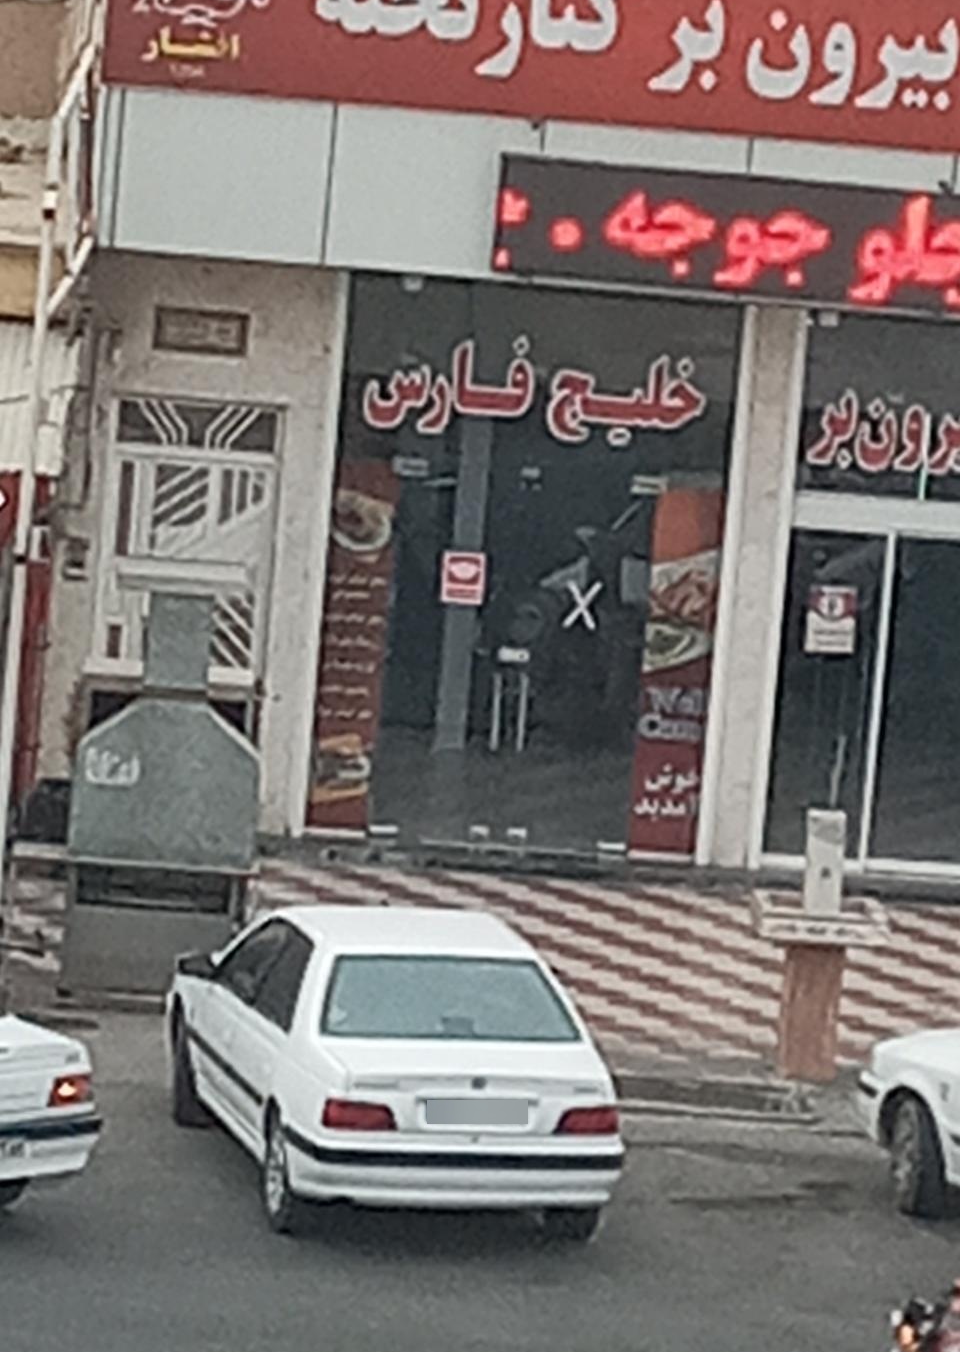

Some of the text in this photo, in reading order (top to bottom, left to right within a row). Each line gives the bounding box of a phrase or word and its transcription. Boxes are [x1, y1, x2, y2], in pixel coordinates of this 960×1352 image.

[746, 9, 960, 111] بیرون
[603, 190, 832, 288] جوجه
[362, 334, 706, 446] خلیج فارس
